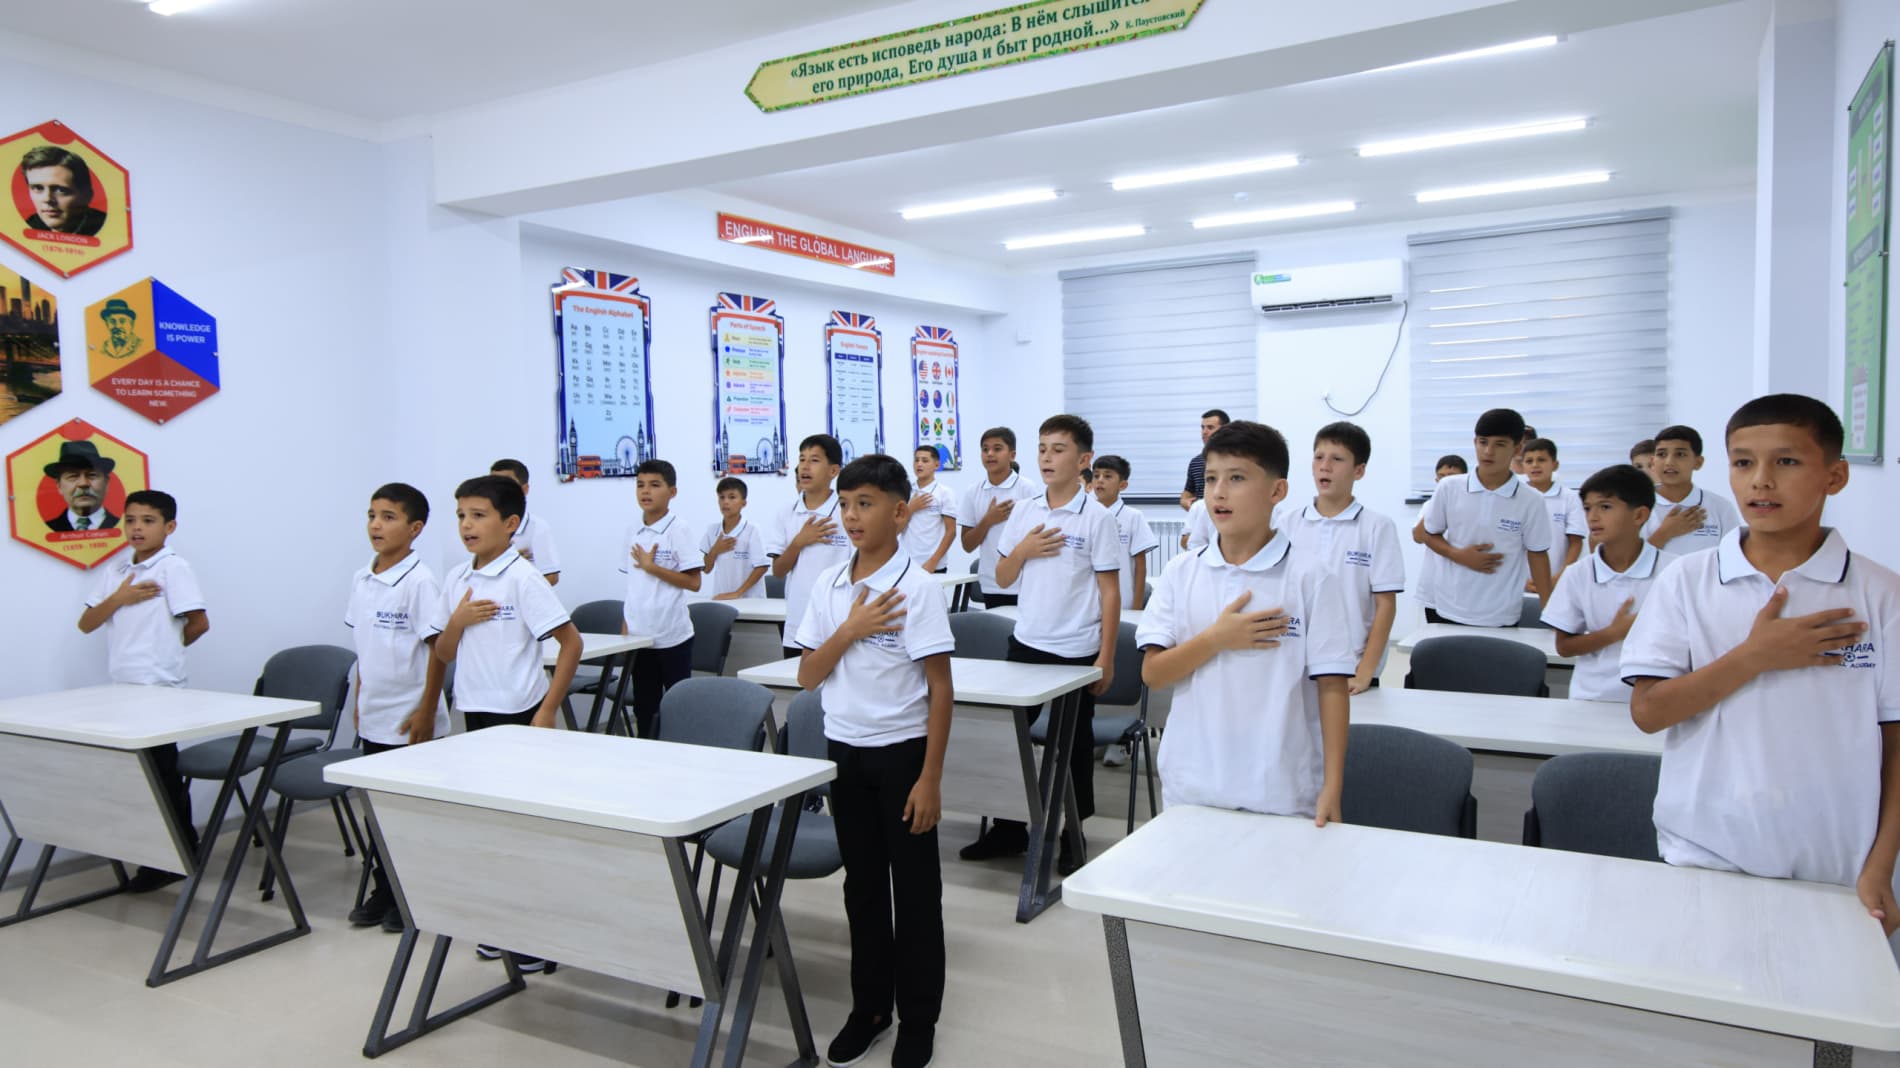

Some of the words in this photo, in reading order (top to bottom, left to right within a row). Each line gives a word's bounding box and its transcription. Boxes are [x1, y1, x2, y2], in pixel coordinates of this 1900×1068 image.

[1135, 9, 1186, 28] Паустовский
[791, 59, 835, 78] «Язык
[838, 53, 868, 69] есть
[872, 37, 941, 62] исповедь
[945, 24, 1007, 47] народа:
[1011, 16, 1022, 32] В
[1027, 12, 1057, 29] нём
[812, 79, 834, 94] его
[838, 67, 904, 91] природа,
[908, 57, 933, 76] Его
[937, 51, 977, 71] душа
[982, 47, 992, 60] и
[997, 38, 1027, 57] быт
[37, 232, 54, 240] JACK
[55, 233, 88, 244] LONDON
[777, 231, 797, 249] THE
[800, 237, 840, 259] GLOBAL
[159, 322, 211, 333] KNOWLEDGE
[166, 334, 174, 342] IS
[176, 334, 206, 343] POWER
[171, 380, 200, 388] CHANCE
[115, 388, 126, 396] TO
[128, 388, 152, 396] LEARN
[154, 389, 197, 398] SOMETHING
